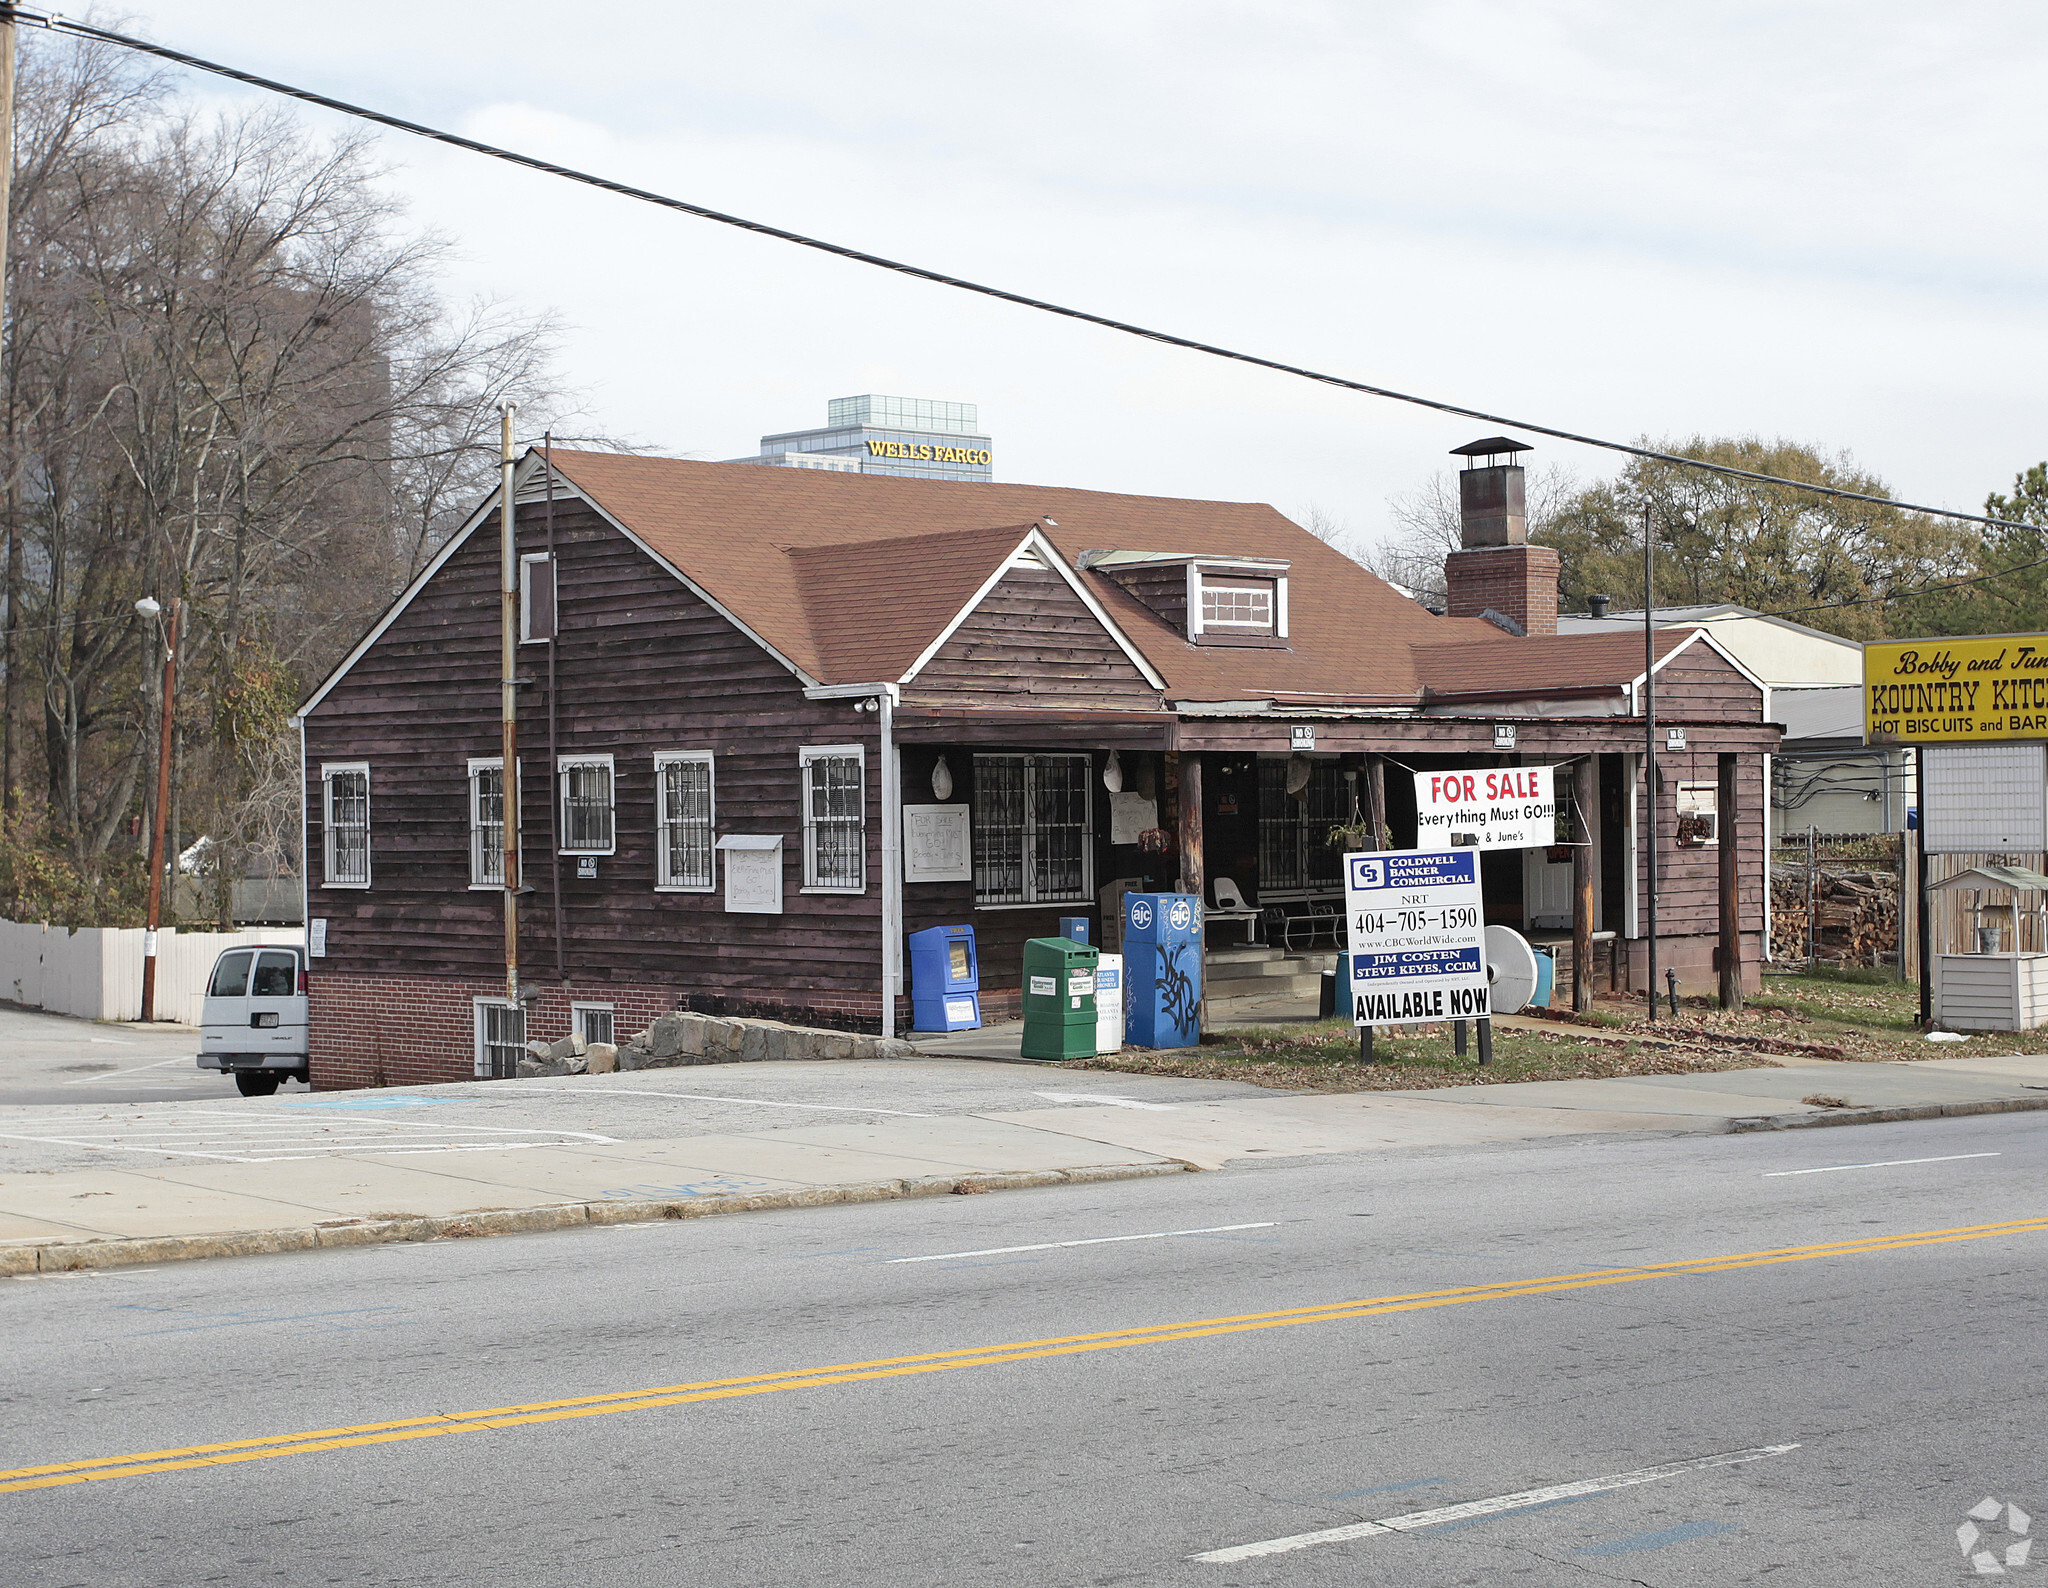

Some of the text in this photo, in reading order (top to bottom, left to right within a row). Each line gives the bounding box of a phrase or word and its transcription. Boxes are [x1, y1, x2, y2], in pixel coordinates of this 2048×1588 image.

[868, 440, 992, 465] WELLS FARGO
[1893, 650, 1962, 680] Bobby
[1966, 648, 2007, 671] and
[1871, 678, 2048, 714] KOUNTRY KITC
[1872, 715, 2047, 734] HOT BISCUITS and BAR
[1431, 772, 1539, 803] FOR SALE
[1419, 804, 1554, 828] Everything Must GO!!!
[1485, 832, 1492, 842] &
[1498, 830, 1524, 842] June's
[1389, 856, 1457, 868] COLDWELL
[1389, 867, 1439, 878] BANKER
[1390, 874, 1472, 887] COMMERCIAL
[1401, 894, 1429, 905] NRT
[1133, 906, 1150, 924] ajc
[1172, 904, 1188, 925] ajc
[1355, 907, 1477, 934] 404-705-1590
[1358, 935, 1476, 949] www.CBCWorldWide.com
[1372, 950, 1461, 967] JIM COSTEN
[1356, 961, 1478, 978] STEVE KEYES, CCIM
[1355, 987, 1487, 1021] AVAILABLE NOW
